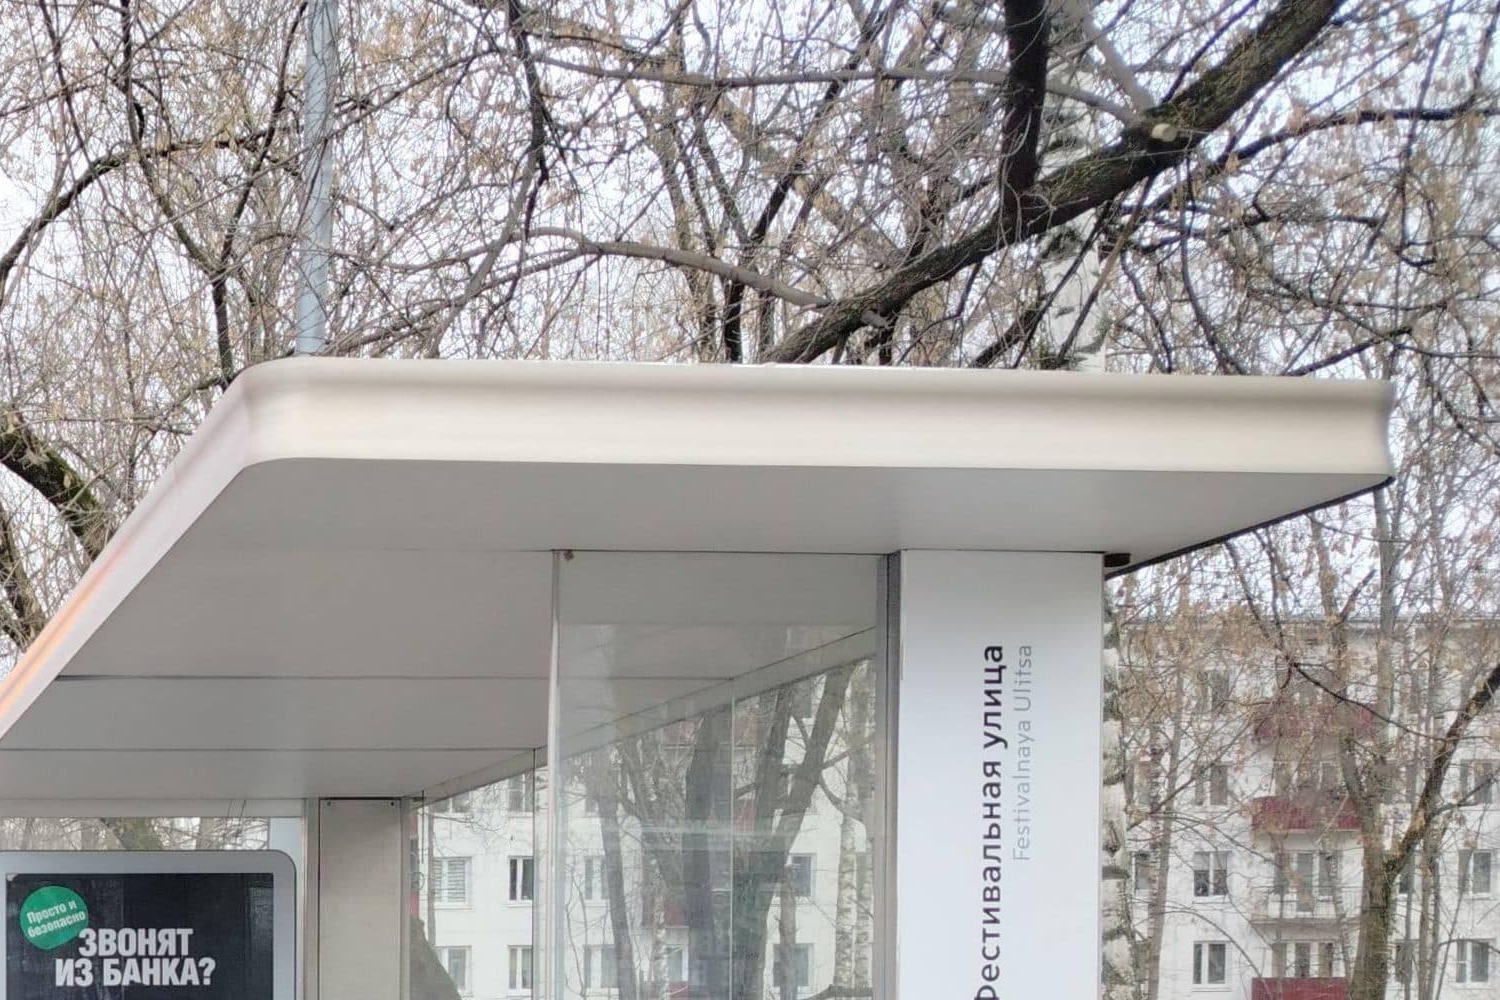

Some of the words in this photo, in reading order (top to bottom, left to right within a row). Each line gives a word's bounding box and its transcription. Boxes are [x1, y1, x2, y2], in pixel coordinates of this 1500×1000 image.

[1013, 645, 1032, 712] Ulitsa
[983, 645, 1008, 749] улица
[1012, 719, 1034, 861] Festivalnaya
[27, 902, 67, 924] Просто
[68, 900, 78, 910] и
[27, 911, 86, 938] безопасно
[78, 928, 194, 957] ЗВОНЯТ
[55, 958, 94, 987] ИЗ
[102, 957, 216, 987] БАНКА?
